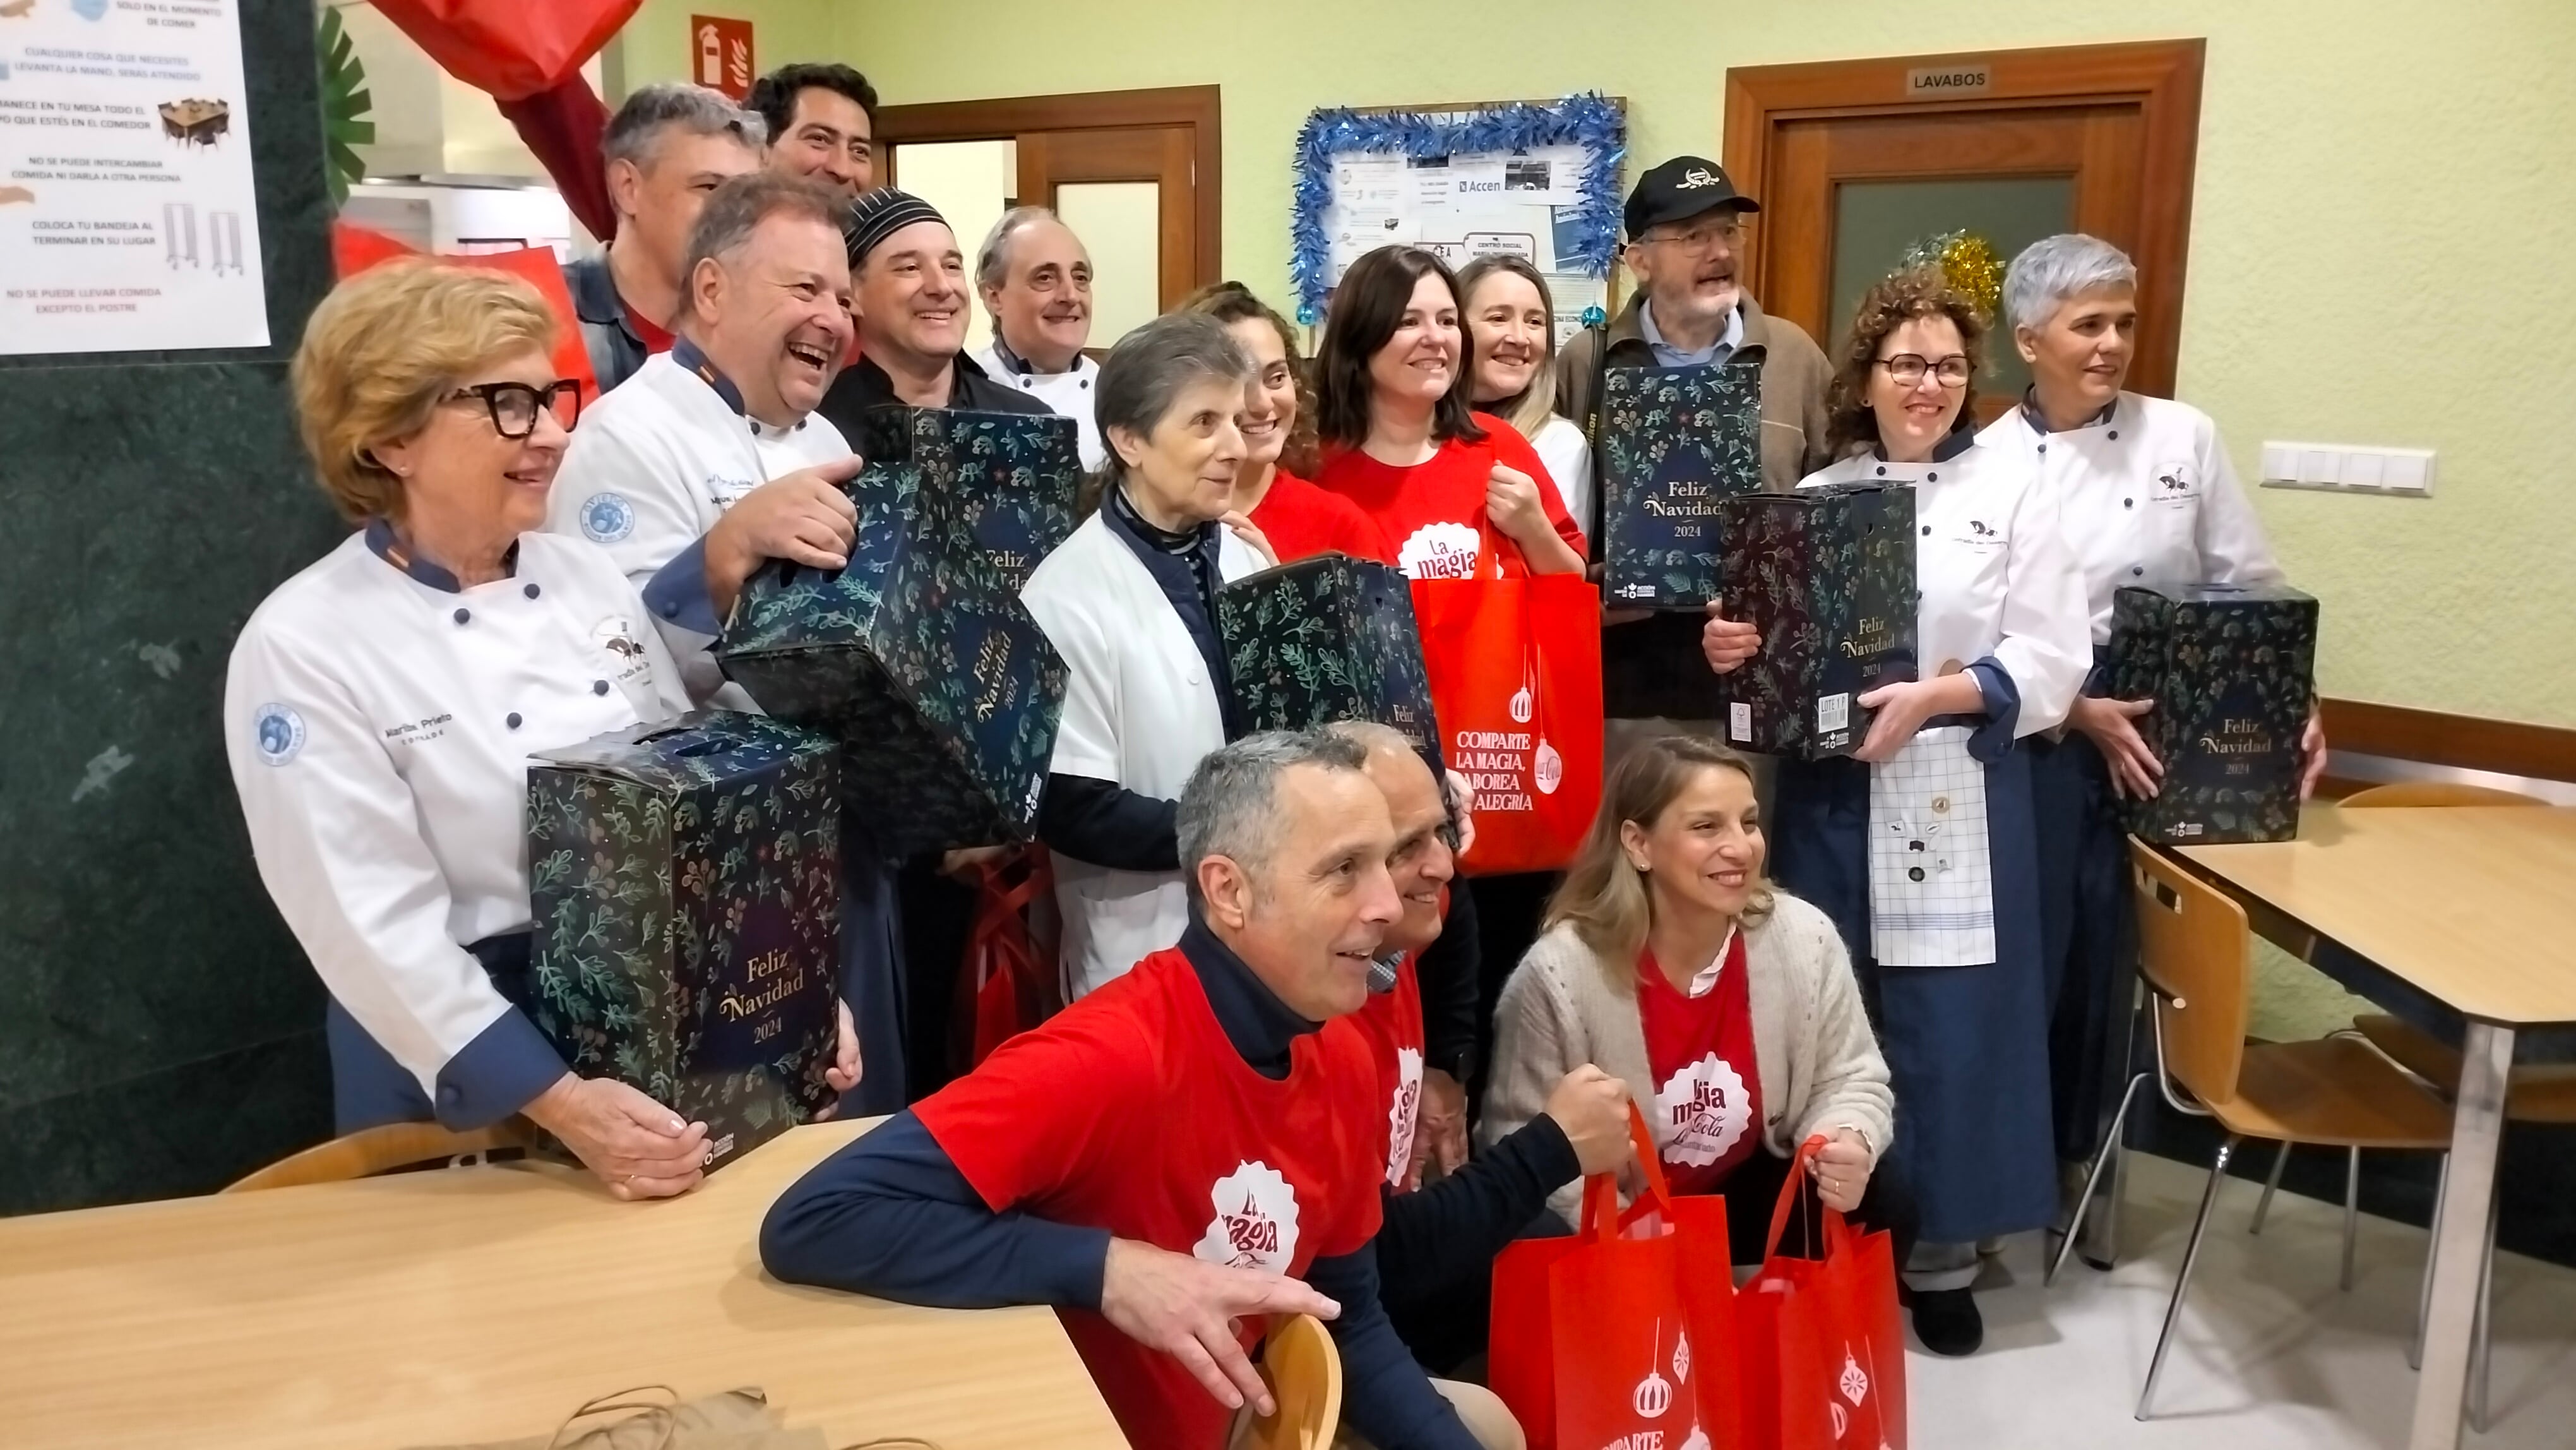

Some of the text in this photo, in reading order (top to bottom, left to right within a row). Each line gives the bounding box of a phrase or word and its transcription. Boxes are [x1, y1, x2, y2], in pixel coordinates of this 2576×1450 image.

[144, 3, 156, 11] EN
[158, 4, 168, 13] EL
[172, 6, 222, 16] MOMENTO
[146, 18, 195, 28] DE COMER
[25, 47, 189, 66] CUALQUIER COSA QUE NECESITES
[15, 61, 62, 73] LEVANTA
[66, 65, 77, 74] LA
[151, 71, 201, 81] ATENDIDO
[1915, 73, 1985, 88] LAVABOS
[41, 102, 54, 110] EN
[57, 102, 71, 111] TU
[74, 104, 101, 112] MESA
[105, 105, 133, 114] TODO
[135, 106, 145, 115] EL
[15, 116, 36, 125] QUE
[72, 118, 85, 127] EN
[88, 119, 98, 128] EL
[101, 120, 151, 129] COMEDOR
[29, 157, 44, 165] NO
[61, 158, 91, 166] PUEDE
[94, 159, 163, 168] INTERCAMBIAR
[12, 171, 53, 179] COMIDA
[69, 172, 100, 181] DARLA
[138, 174, 181, 183] PERSONA
[32, 221, 153, 231] COLOCA TU BANDEJA AL
[33, 236, 156, 245] TERMINAR EN SU LUGAR
[6, 288, 162, 299] NO SE PUEDE LLEVAR COMIDA
[36, 304, 137, 314] EXCEPTO EL POSTRE
[1668, 481, 1708, 497] Feliz
[1643, 500, 1723, 517] Navidad
[1674, 525, 1701, 537] 2024
[1429, 539, 1449, 555] La
[1417, 548, 1476, 579] magia
[1859, 616, 1885, 635] Feliz
[1840, 633, 1895, 658] Navidad
[974, 636, 994, 685] Feliz
[977, 632, 1011, 723] Navidad
[1863, 662, 1881, 677] 2024
[1005, 675, 1019, 711] 2024
[1393, 704, 1414, 723] Feliz
[1822, 699, 1835, 712] LOTE
[2224, 719, 2260, 734] Feliz
[1457, 731, 1531, 750] COMPARTE
[2199, 737, 2271, 753] Navidad
[1456, 752, 1474, 769] LA
[1476, 752, 1526, 772] MAGIA,
[2226, 764, 2249, 775] 2024
[1462, 772, 1520, 791] ABOREA
[1474, 792, 1534, 811] ALEGRÍA
[747, 949, 789, 983] Feliz
[719, 968, 803, 1022] Navidad
[754, 1016, 782, 1044] 2024
